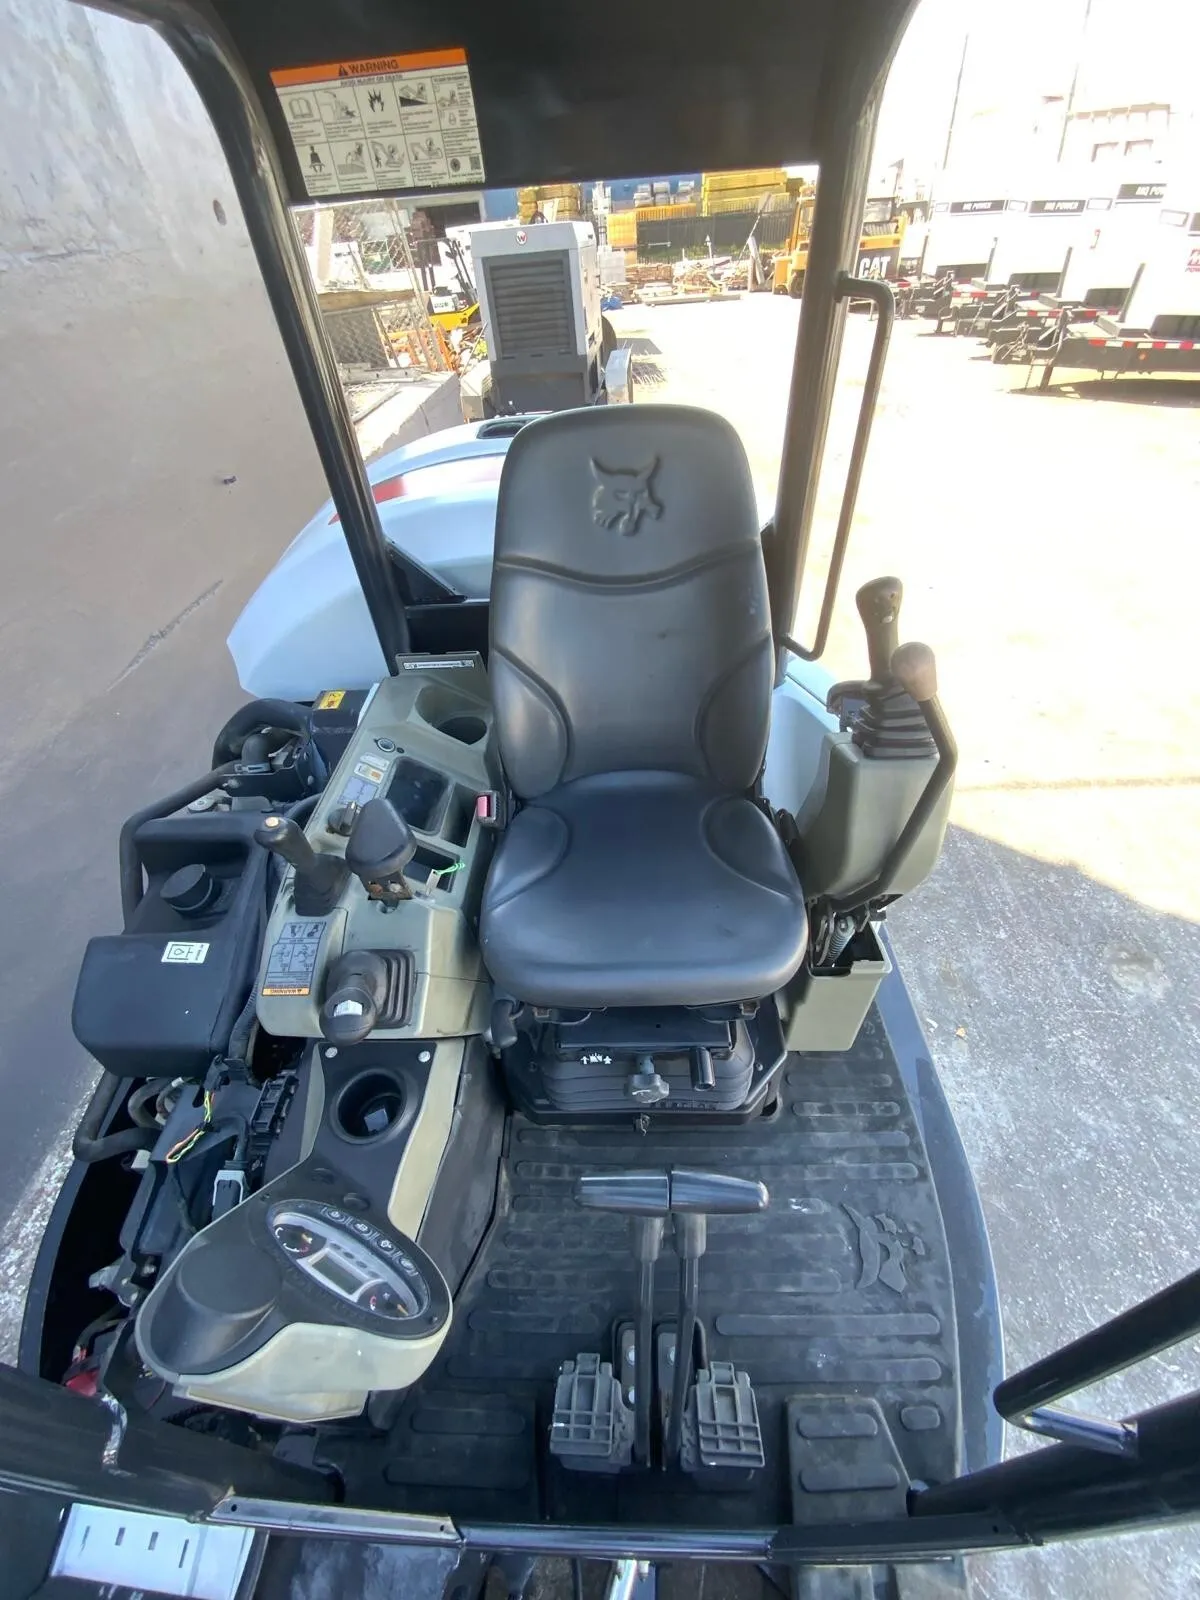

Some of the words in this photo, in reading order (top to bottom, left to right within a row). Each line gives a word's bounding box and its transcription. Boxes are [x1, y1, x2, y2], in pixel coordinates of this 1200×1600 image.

[348, 59, 399, 74] WARNING
[1055, 201, 1079, 211] POWER
[858, 255, 891, 280] CAT
